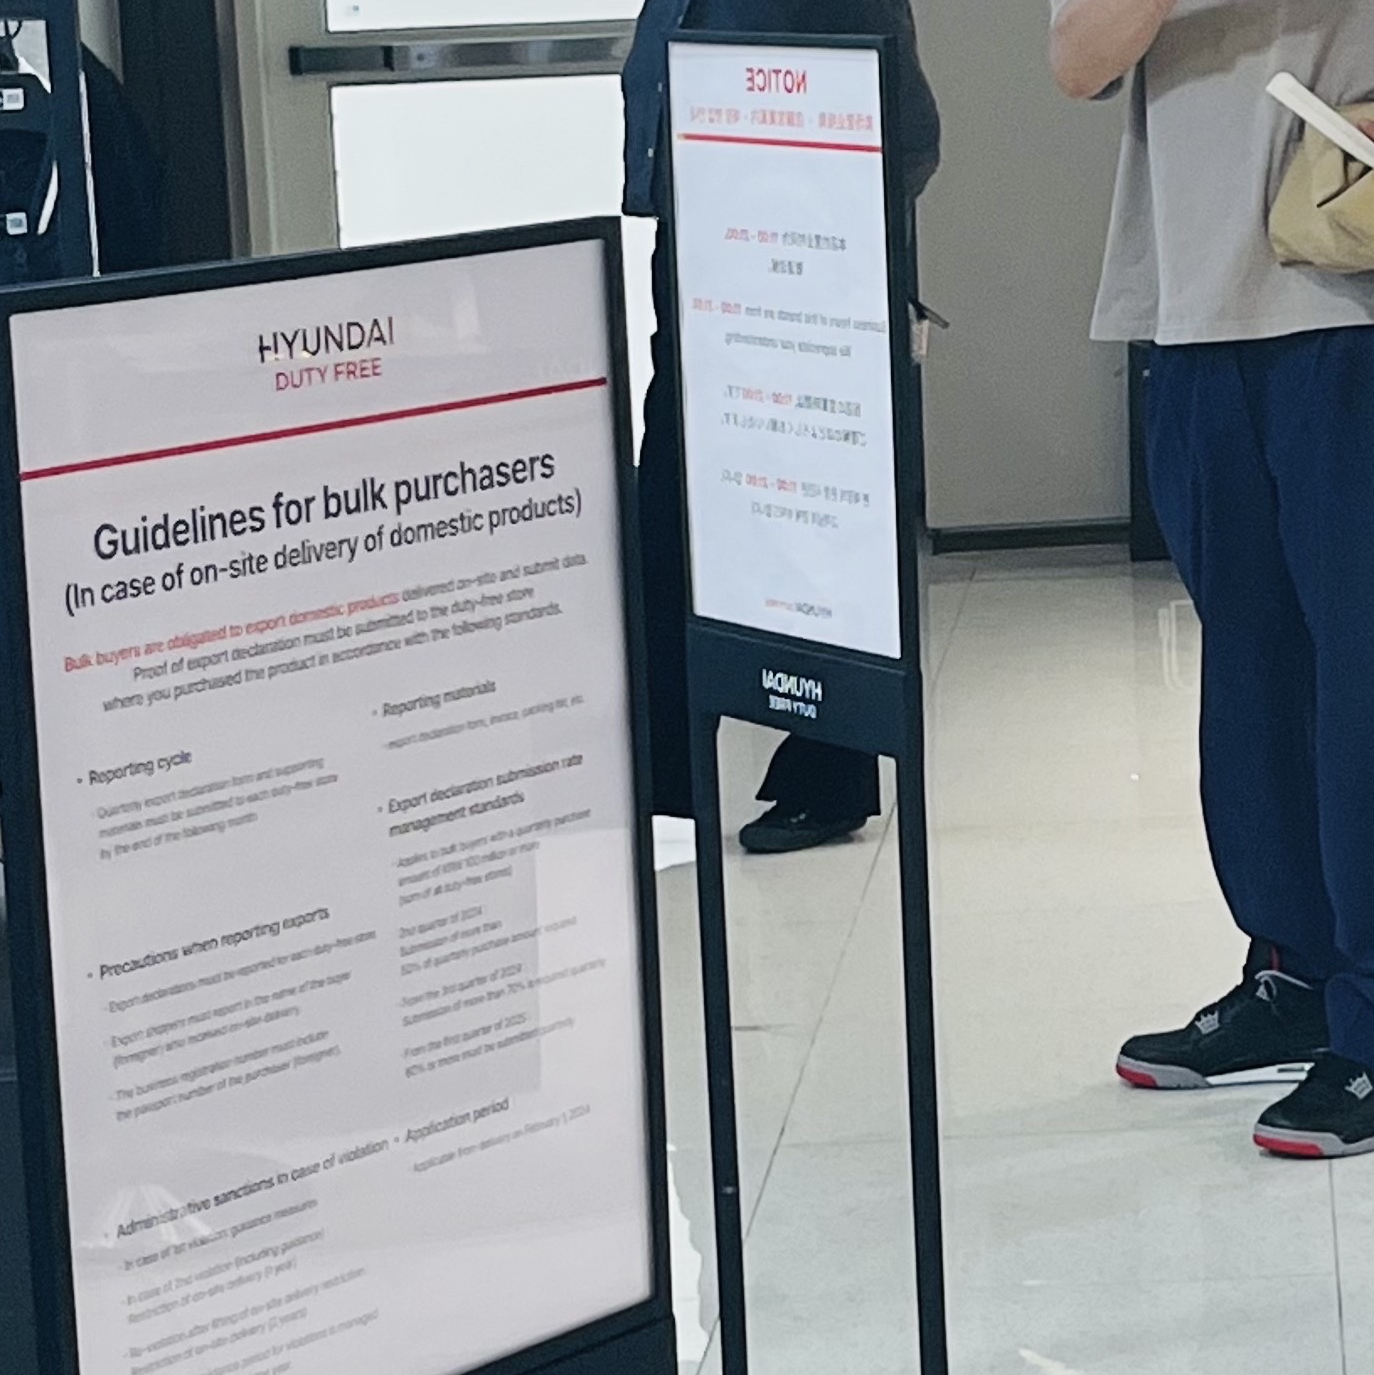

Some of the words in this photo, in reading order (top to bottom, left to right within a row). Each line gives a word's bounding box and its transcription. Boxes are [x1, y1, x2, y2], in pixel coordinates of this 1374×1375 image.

[258, 316, 394, 364] HYUNDAI
[274, 364, 329, 392] DUTY
[333, 356, 382, 382] FREE
[93, 505, 266, 561] Guidelines
[272, 491, 316, 529] for
[322, 476, 388, 520] bulk
[394, 453, 555, 516] purchasers
[65, 582, 95, 618] (In
[100, 575, 156, 604] case
[161, 562, 184, 592] of
[189, 552, 269, 586] on-site
[273, 535, 359, 571] delivery
[363, 523, 385, 553] of
[389, 511, 484, 548] domestic
[488, 487, 582, 536] products)
[382, 693, 442, 718] Reporting
[442, 679, 497, 703] materials
[88, 760, 155, 786] Reporting
[156, 750, 193, 773] cycle
[387, 791, 428, 815] Export
[429, 776, 494, 803] declaration
[495, 760, 560, 787] submission
[560, 754, 584, 769] rate
[388, 806, 467, 838] management
[467, 790, 526, 817] standards
[99, 948, 179, 981] Precautions
[181, 937, 219, 957] when
[220, 921, 281, 948] reporting
[282, 907, 331, 930] exports
[404, 1111, 473, 1144] Application
[472, 1096, 510, 1124] period
[116, 1198, 212, 1240] Administrative
[212, 1176, 276, 1207] sanctions
[276, 1172, 289, 1185] in
[290, 1161, 321, 1182] case
[322, 1152, 336, 1171] of
[337, 1139, 389, 1165] violation
